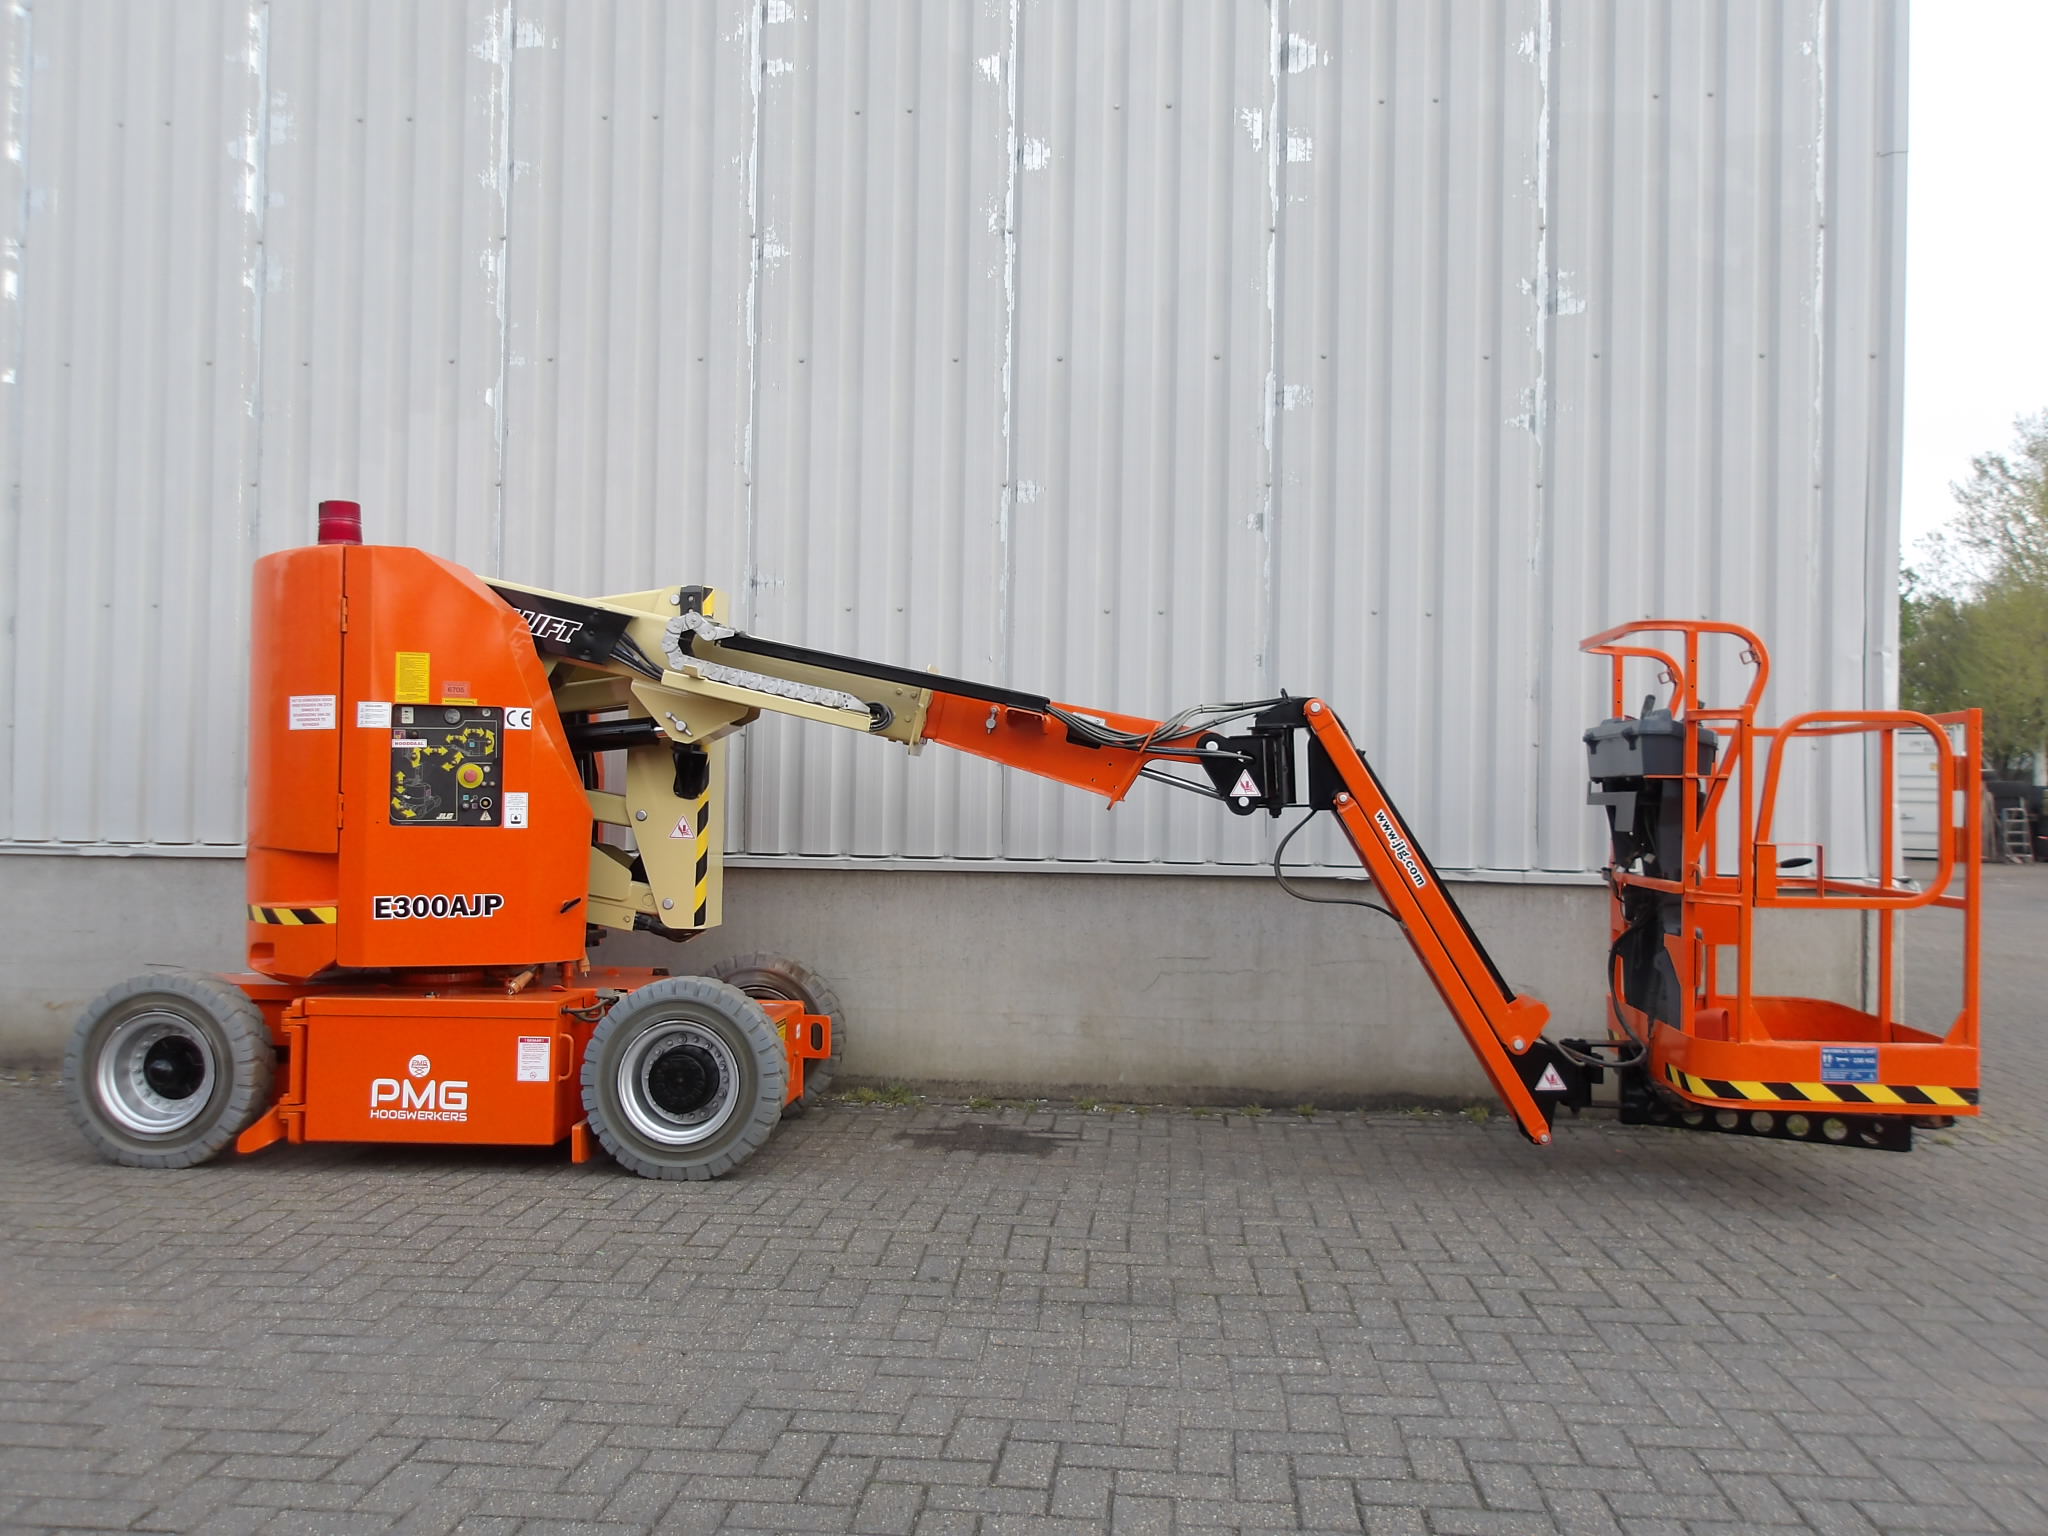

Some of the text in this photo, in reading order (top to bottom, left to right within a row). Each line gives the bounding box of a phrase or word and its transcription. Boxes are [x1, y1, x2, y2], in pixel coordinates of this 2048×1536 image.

[506, 710, 531, 728] CE
[1374, 808, 1426, 888] www.jlg.com
[373, 893, 504, 920] E300AJP
[371, 1078, 468, 1110] PMG
[370, 1109, 468, 1122] HOOGWERKERS
